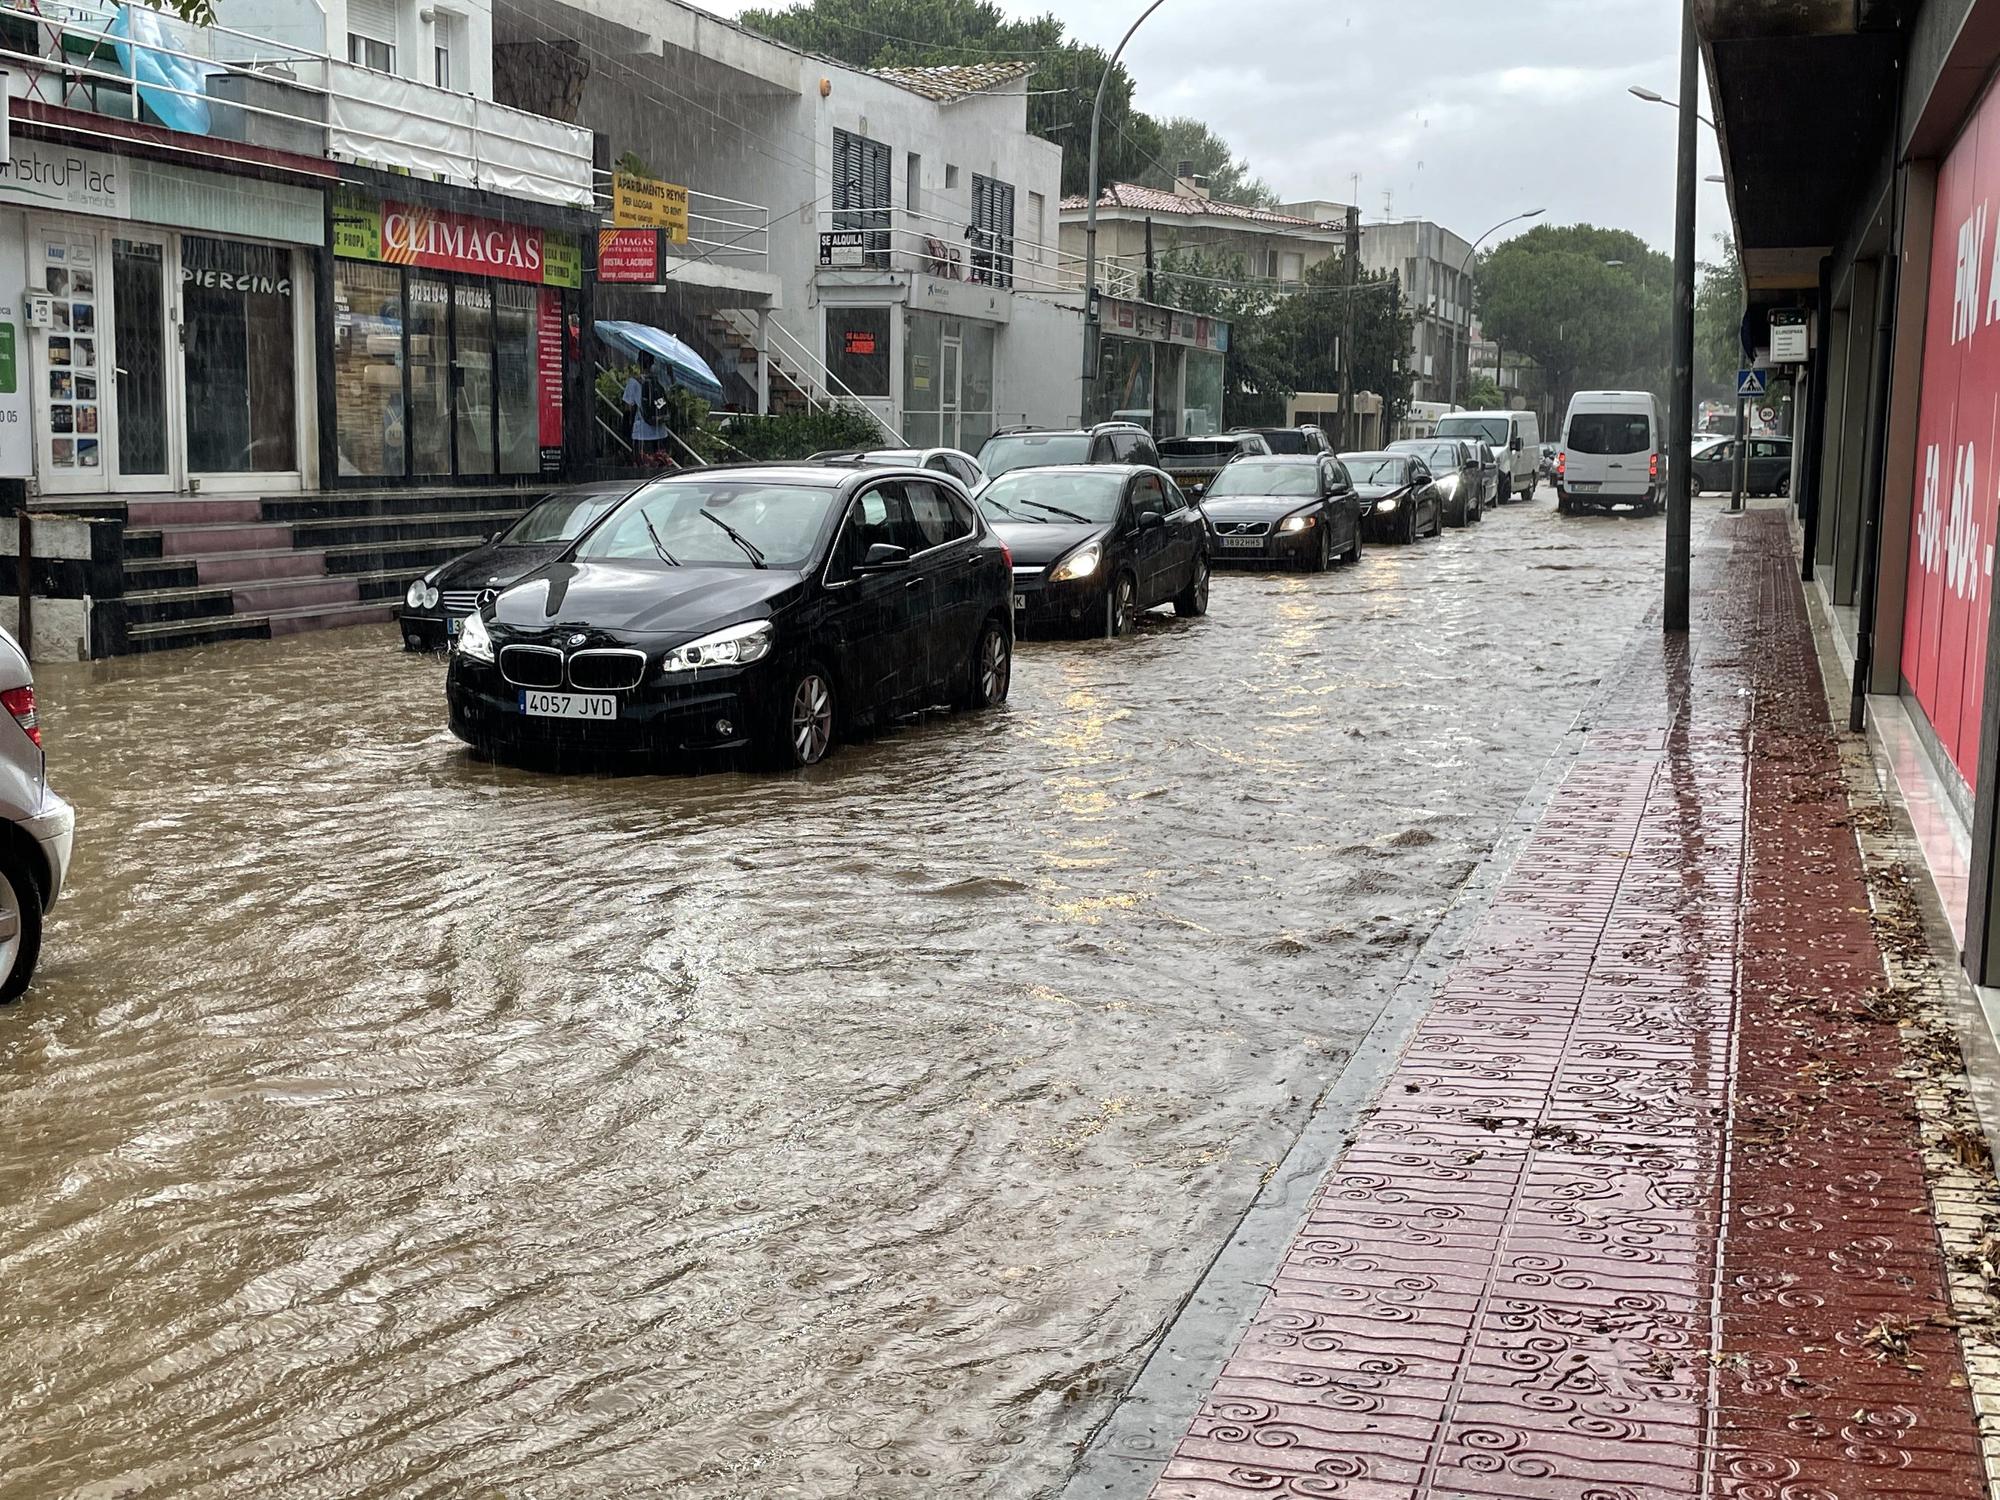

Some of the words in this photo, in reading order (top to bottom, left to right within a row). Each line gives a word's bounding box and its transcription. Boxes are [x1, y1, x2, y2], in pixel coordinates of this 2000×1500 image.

[0, 152, 115, 194] nstruPlac
[618, 177, 665, 199] APARTAMENTS
[622, 196, 632, 206] PER
[384, 213, 540, 270] CLIMAGAS
[821, 235, 831, 246] SE
[832, 234, 863, 246] ALQUILA
[180, 266, 290, 297] PIERCING
[529, 694, 572, 715] 4057
[578, 697, 613, 717] JVD
